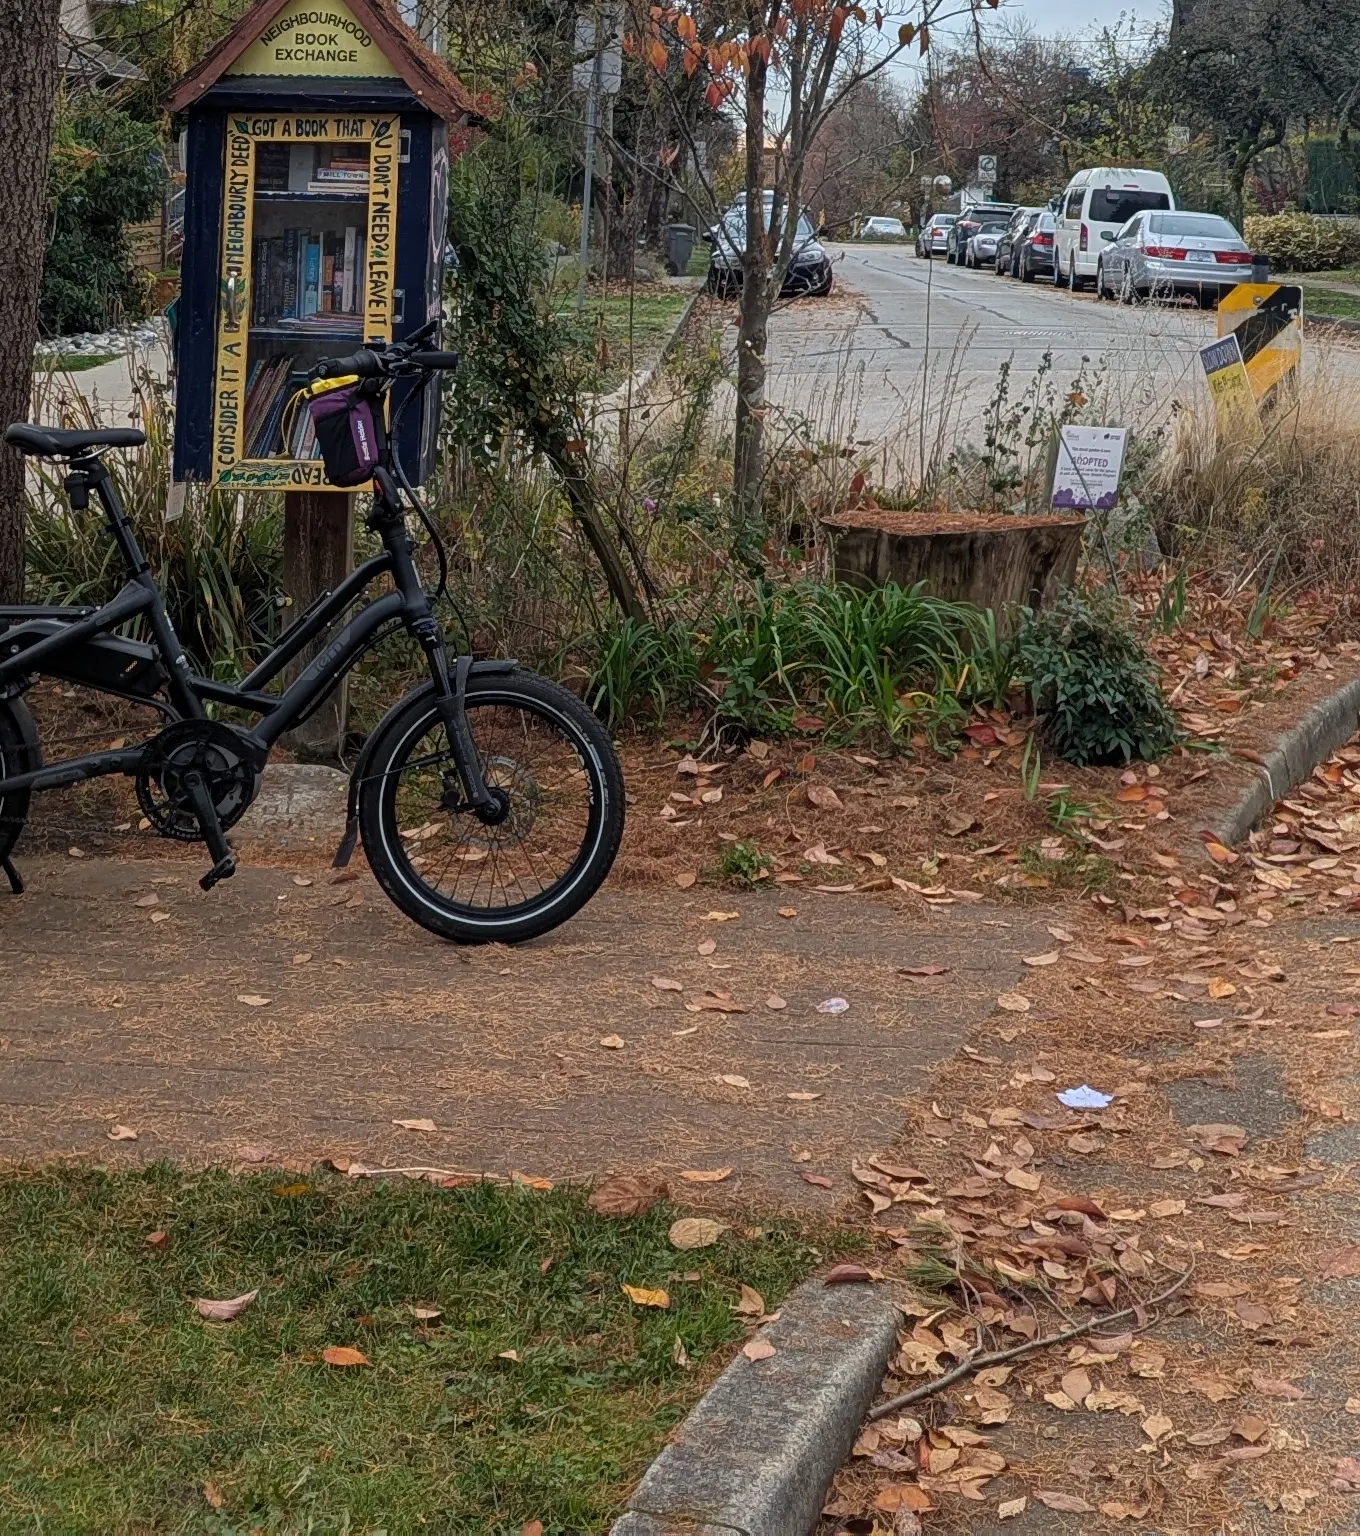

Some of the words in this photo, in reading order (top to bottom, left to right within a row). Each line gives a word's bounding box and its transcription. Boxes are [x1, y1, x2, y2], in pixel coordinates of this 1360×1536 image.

[260, 12, 372, 47] NEIGHBOURHOOD
[295, 33, 339, 46] BOOK
[275, 49, 358, 62] EXCHANGE
[282, 119, 291, 137] A
[295, 119, 329, 137] BOOK
[333, 119, 366, 137] THAT
[372, 154, 392, 199] DON'T
[225, 168, 249, 264] NEIGHBOURLY
[368, 261, 389, 308] LEAVE
[369, 314, 387, 327] IT
[222, 341, 241, 357] A
[220, 365, 240, 382] IT
[217, 389, 239, 465] CONSIDER
[1071, 456, 1108, 468] ADOPTED
